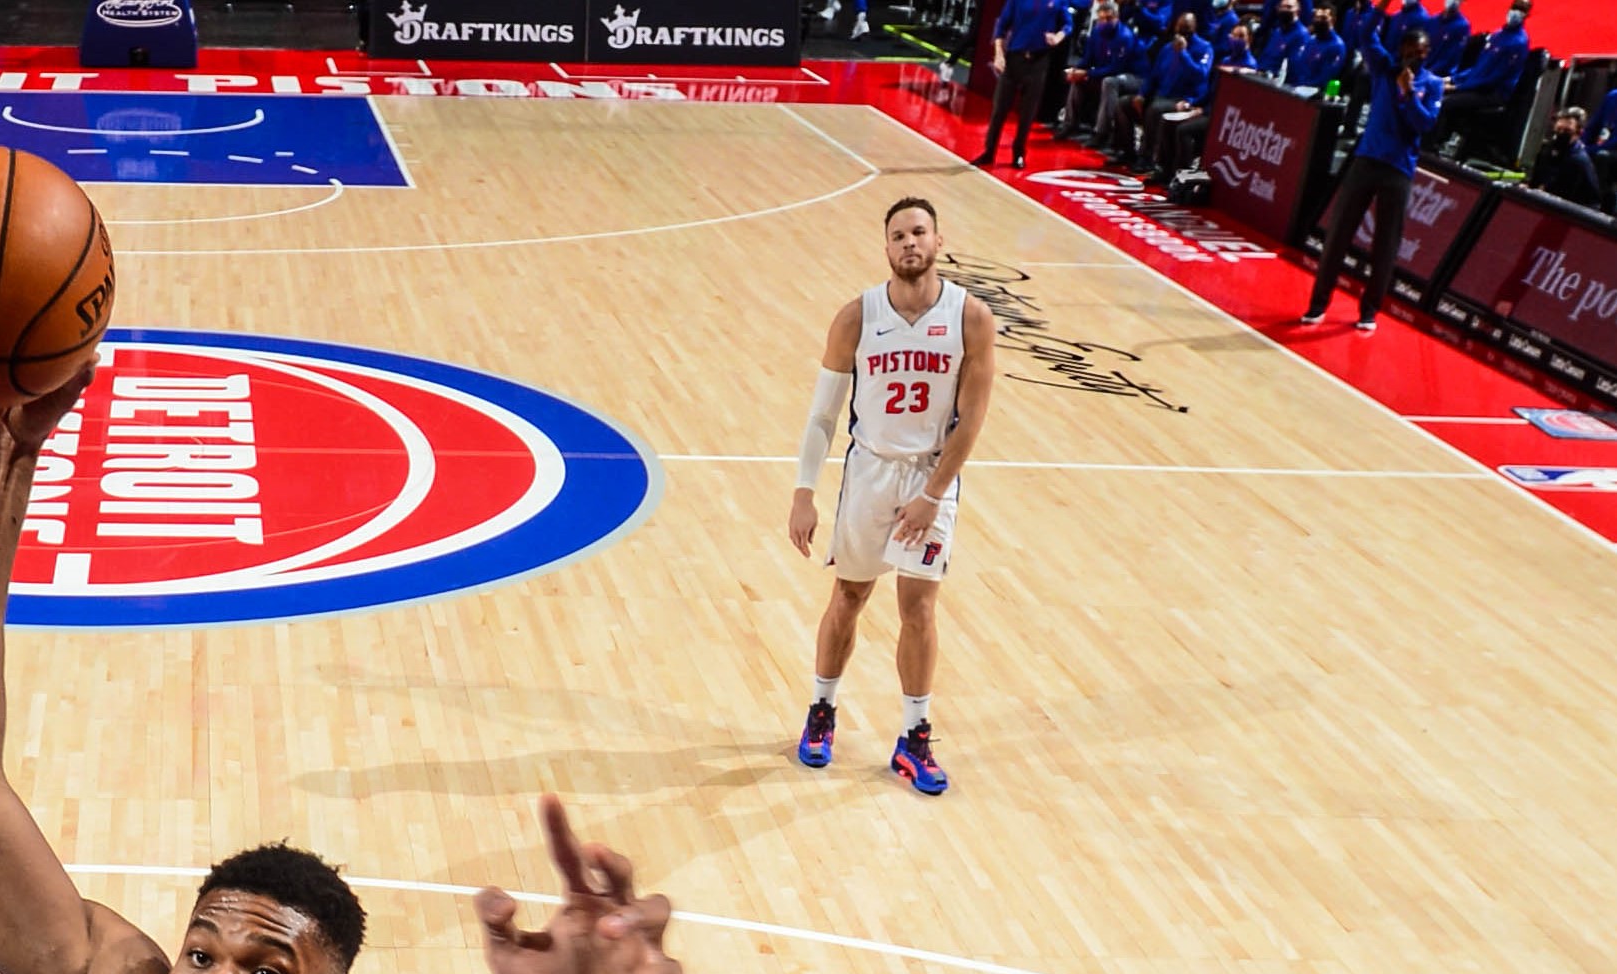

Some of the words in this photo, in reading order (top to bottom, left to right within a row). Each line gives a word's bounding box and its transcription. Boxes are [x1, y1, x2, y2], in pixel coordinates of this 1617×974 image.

[393, 19, 575, 45] DRAFTKINGS
[607, 25, 785, 49] DRAFTKINGS
[175, 73, 688, 100] PISTONS
[1217, 104, 1291, 166] Flagstar
[1522, 245, 1582, 302] The
[867, 350, 953, 376] PISTONS
[884, 381, 931, 415] 23
[96, 374, 264, 545] DETROIT
